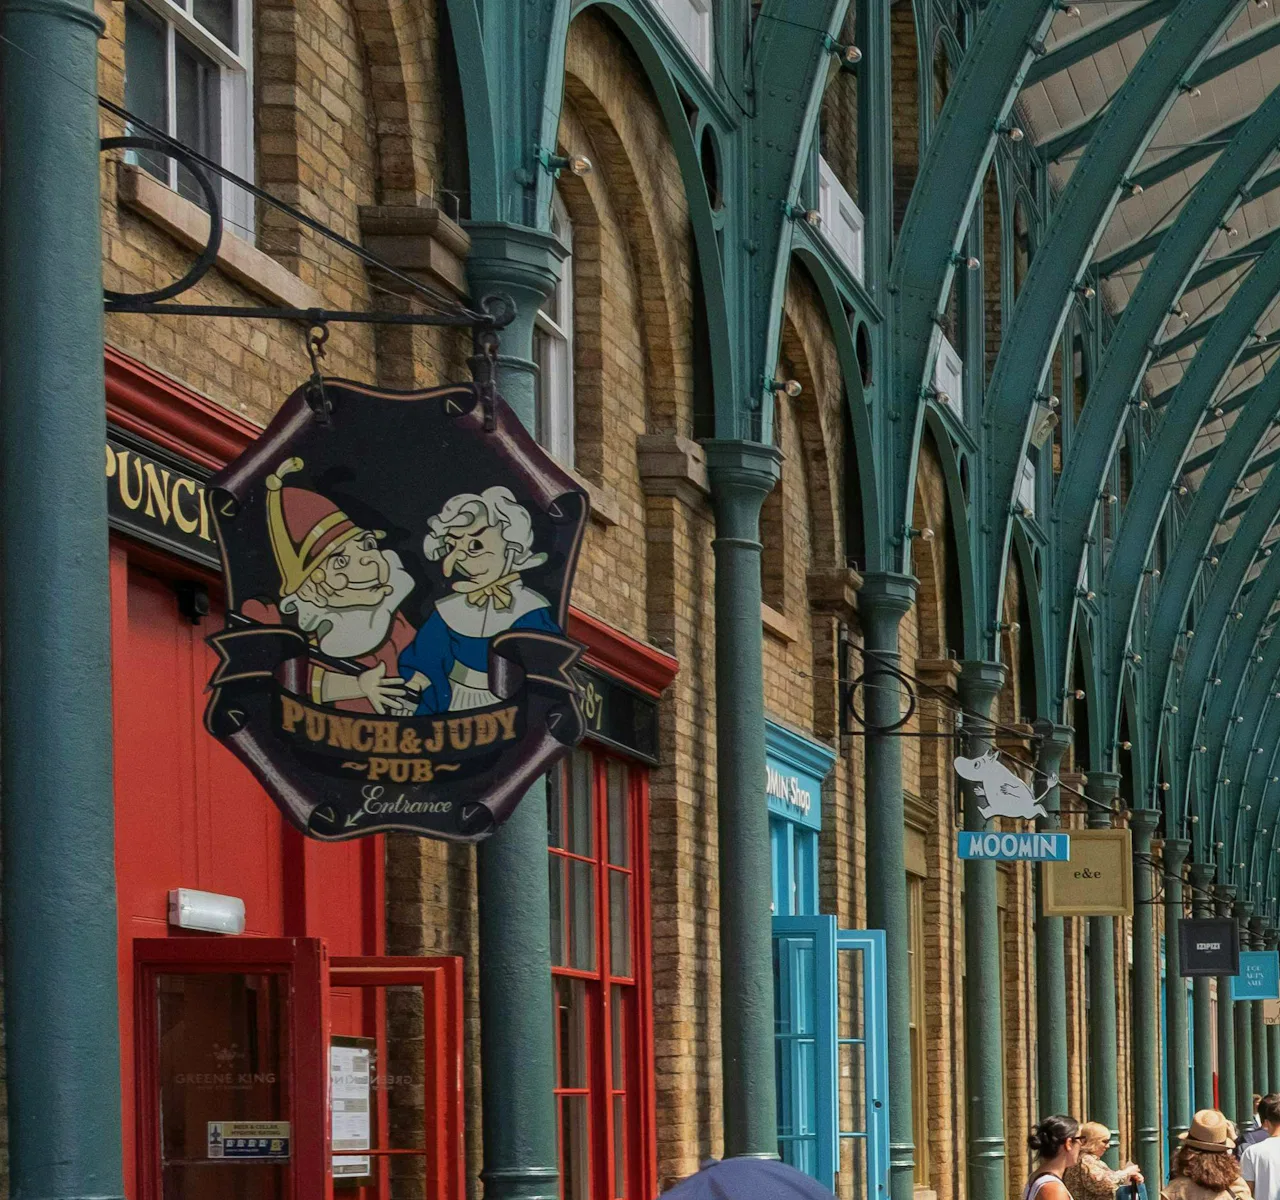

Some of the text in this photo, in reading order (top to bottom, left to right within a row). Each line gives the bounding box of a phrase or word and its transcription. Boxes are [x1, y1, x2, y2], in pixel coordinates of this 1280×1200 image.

[367, 757, 433, 782] PUB
[361, 785, 452, 815] Entrance
[790, 777, 811, 816] Shop
[969, 834, 1057, 858] MOOMIN
[1074, 868, 1101, 879] e&e
[175, 1073, 276, 1085] GREENE KING
